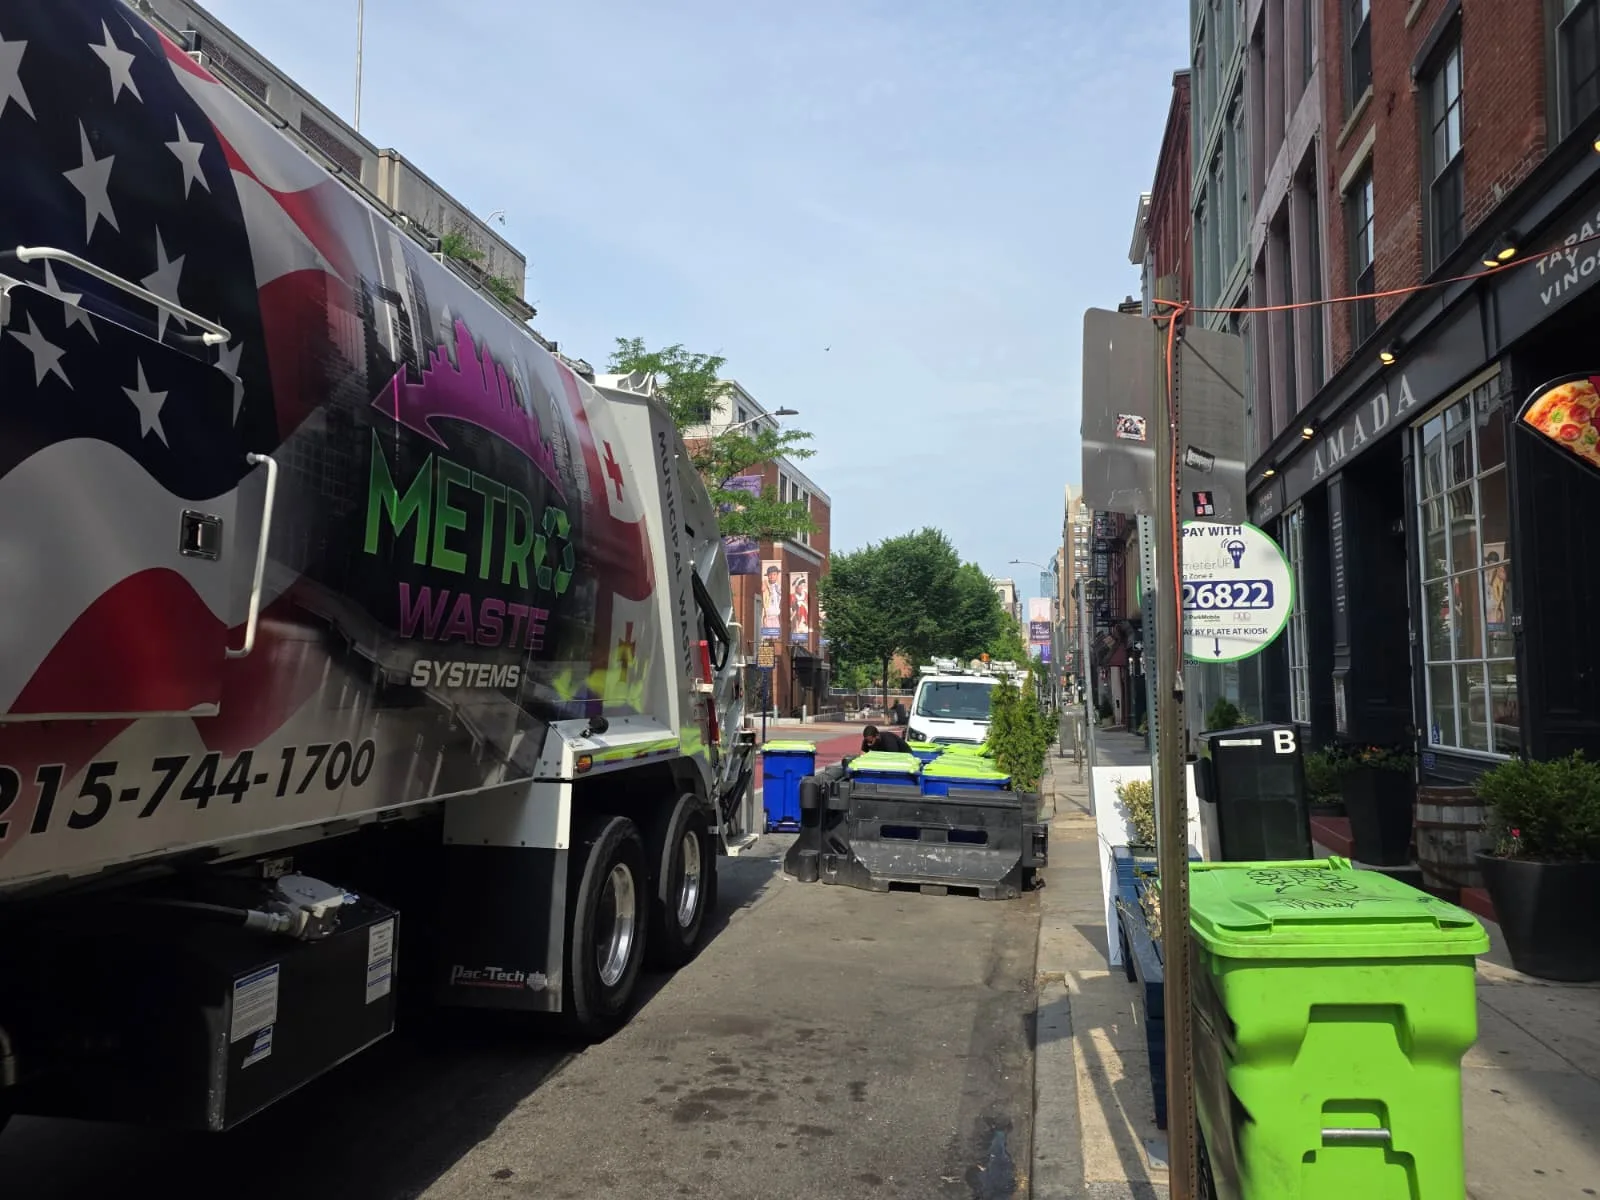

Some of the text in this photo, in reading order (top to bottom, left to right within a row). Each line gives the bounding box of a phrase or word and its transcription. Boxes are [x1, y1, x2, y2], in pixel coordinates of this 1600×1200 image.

[1565, 248, 1579, 268] Y
[1312, 374, 1418, 481] AMADA
[1182, 526, 1242, 537] PAY WITH
[658, 431, 693, 677] MUNICIPAL WASTE
[1183, 582, 1270, 609] 26822
[399, 582, 550, 650] WASTE
[1183, 628, 1194, 636] AY
[1195, 628, 1206, 636] BY
[1206, 628, 1231, 636] PLATE
[1243, 627, 1268, 635] KIOSK
[411, 659, 521, 688] SYSTEMS
[1272, 729, 1297, 754] B
[450, 964, 525, 986] Pac-Tech
